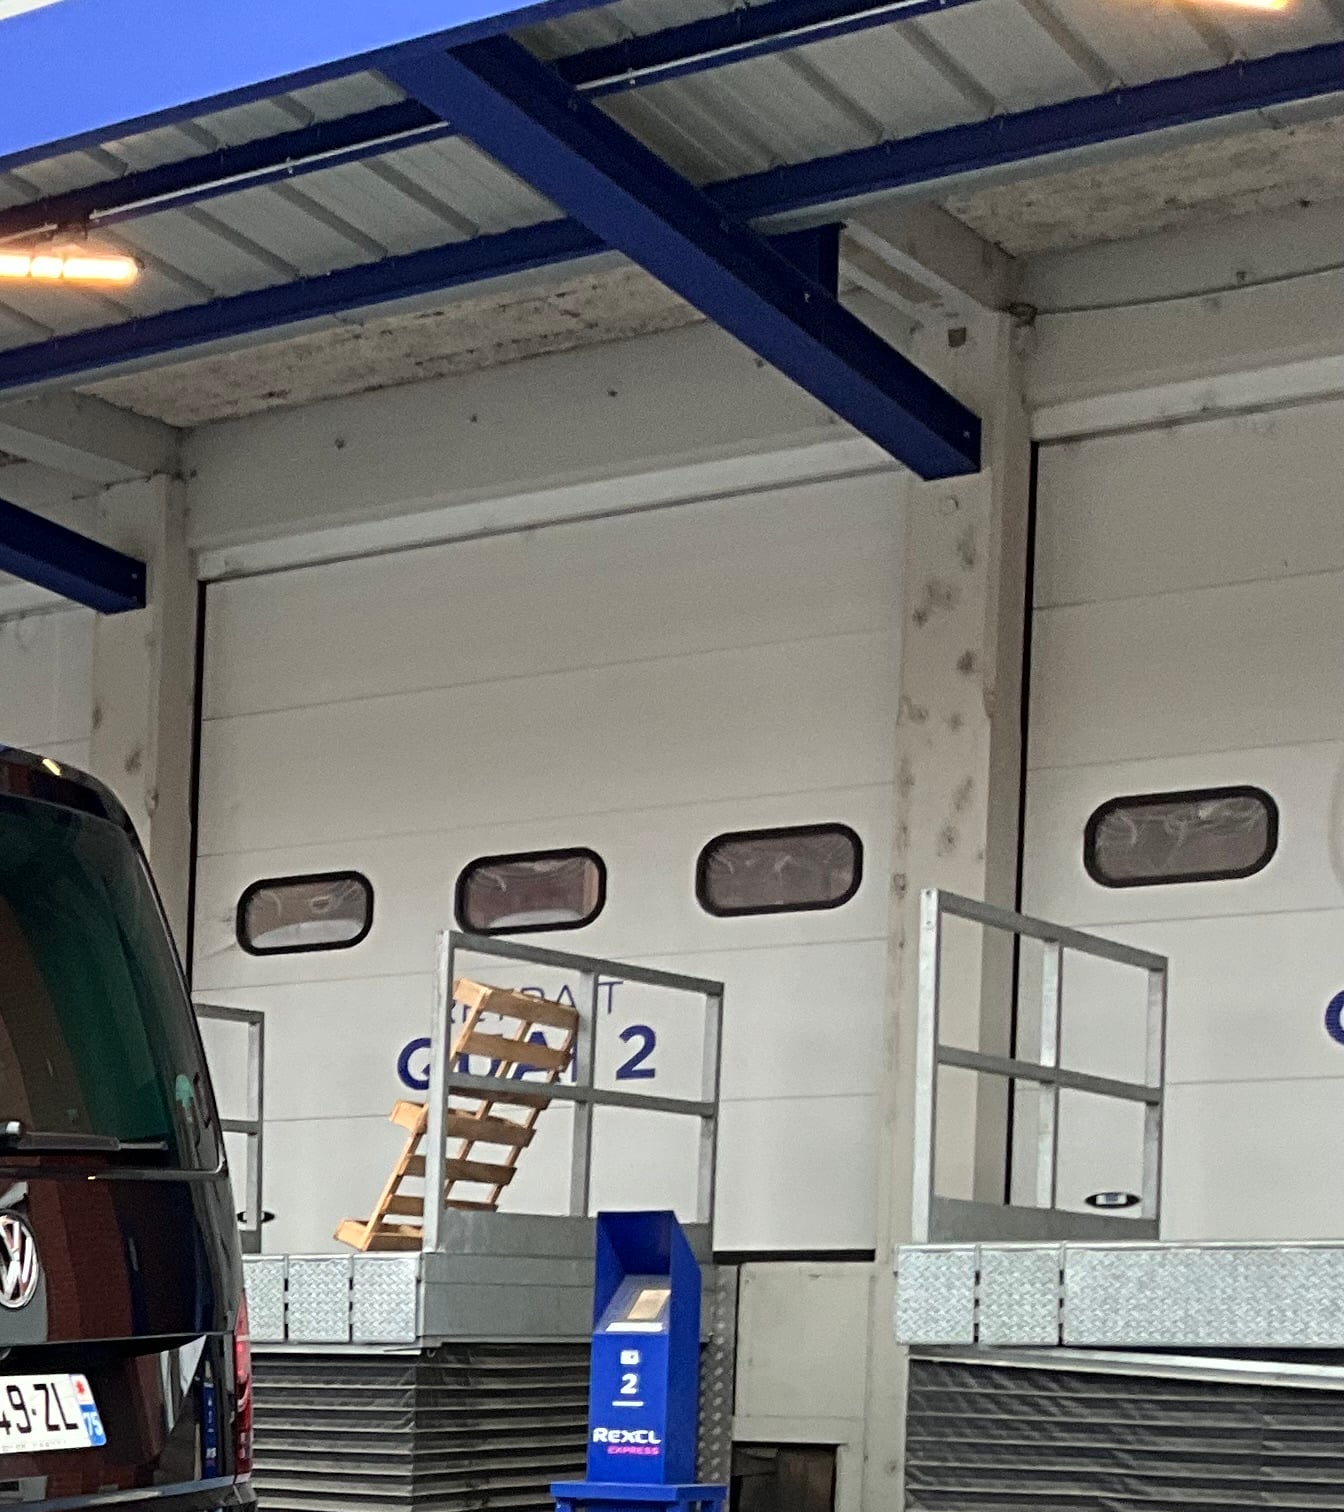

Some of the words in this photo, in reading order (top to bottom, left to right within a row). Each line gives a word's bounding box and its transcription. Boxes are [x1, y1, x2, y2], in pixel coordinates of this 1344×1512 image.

[616, 1024, 656, 1080] 2
[620, 1373, 638, 1395] 2
[84, 1411, 103, 1437] 75
